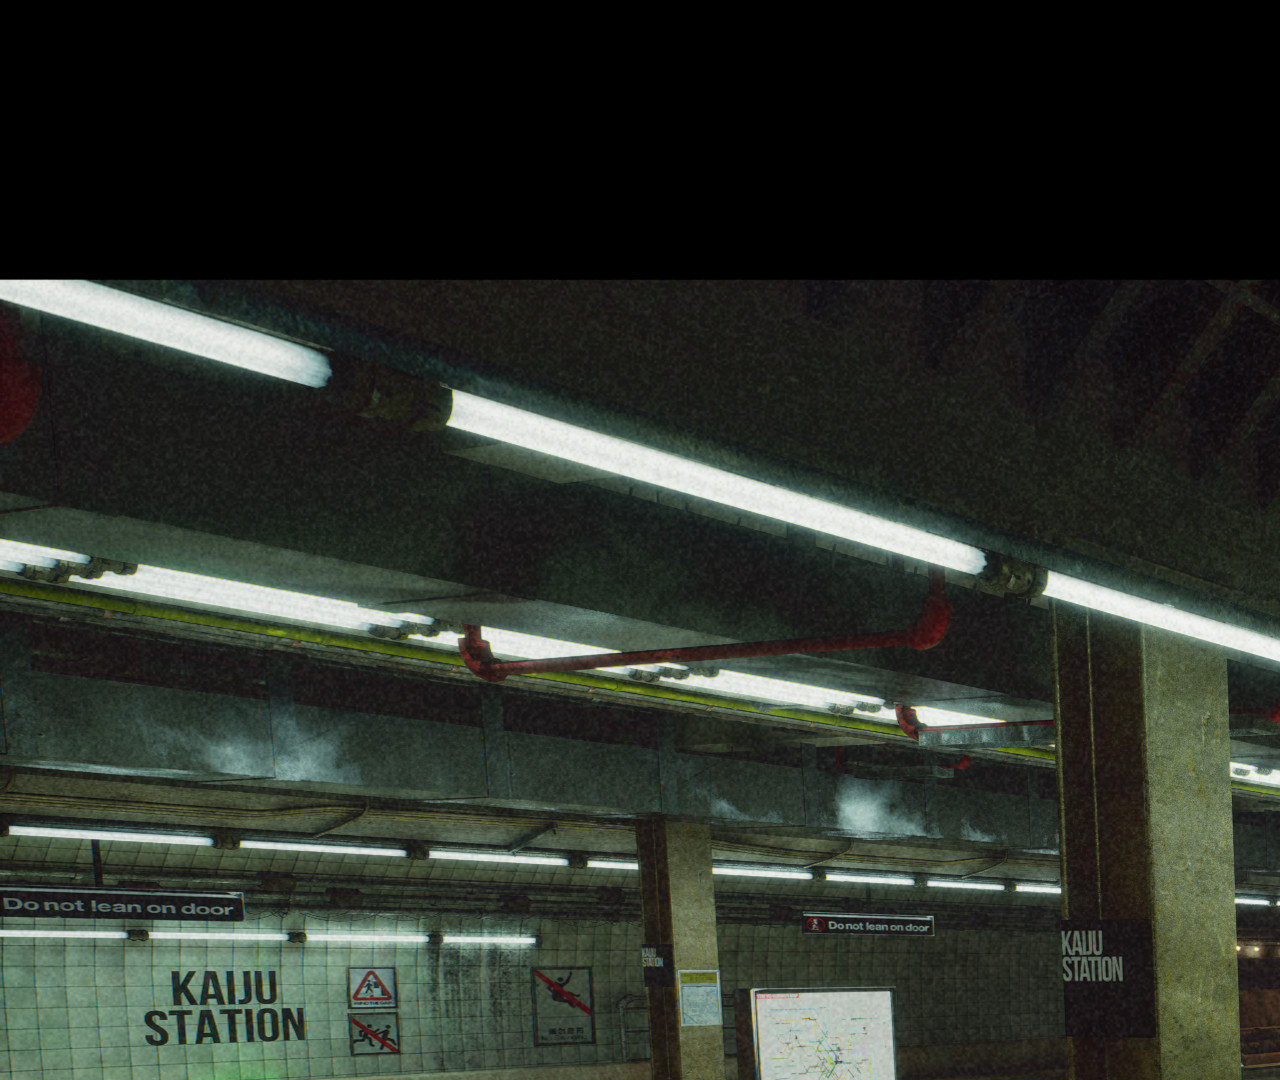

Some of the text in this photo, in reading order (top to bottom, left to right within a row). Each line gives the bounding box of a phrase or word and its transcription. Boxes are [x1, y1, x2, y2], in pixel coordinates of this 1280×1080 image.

[3, 897, 234, 916] Do not lean on door
[828, 921, 930, 933] Do not lean on door
[1061, 930, 1103, 955] KAIJU
[1062, 956, 1124, 982] STATION
[171, 970, 277, 1005] KAIJU
[144, 1007, 305, 1046] STATION
